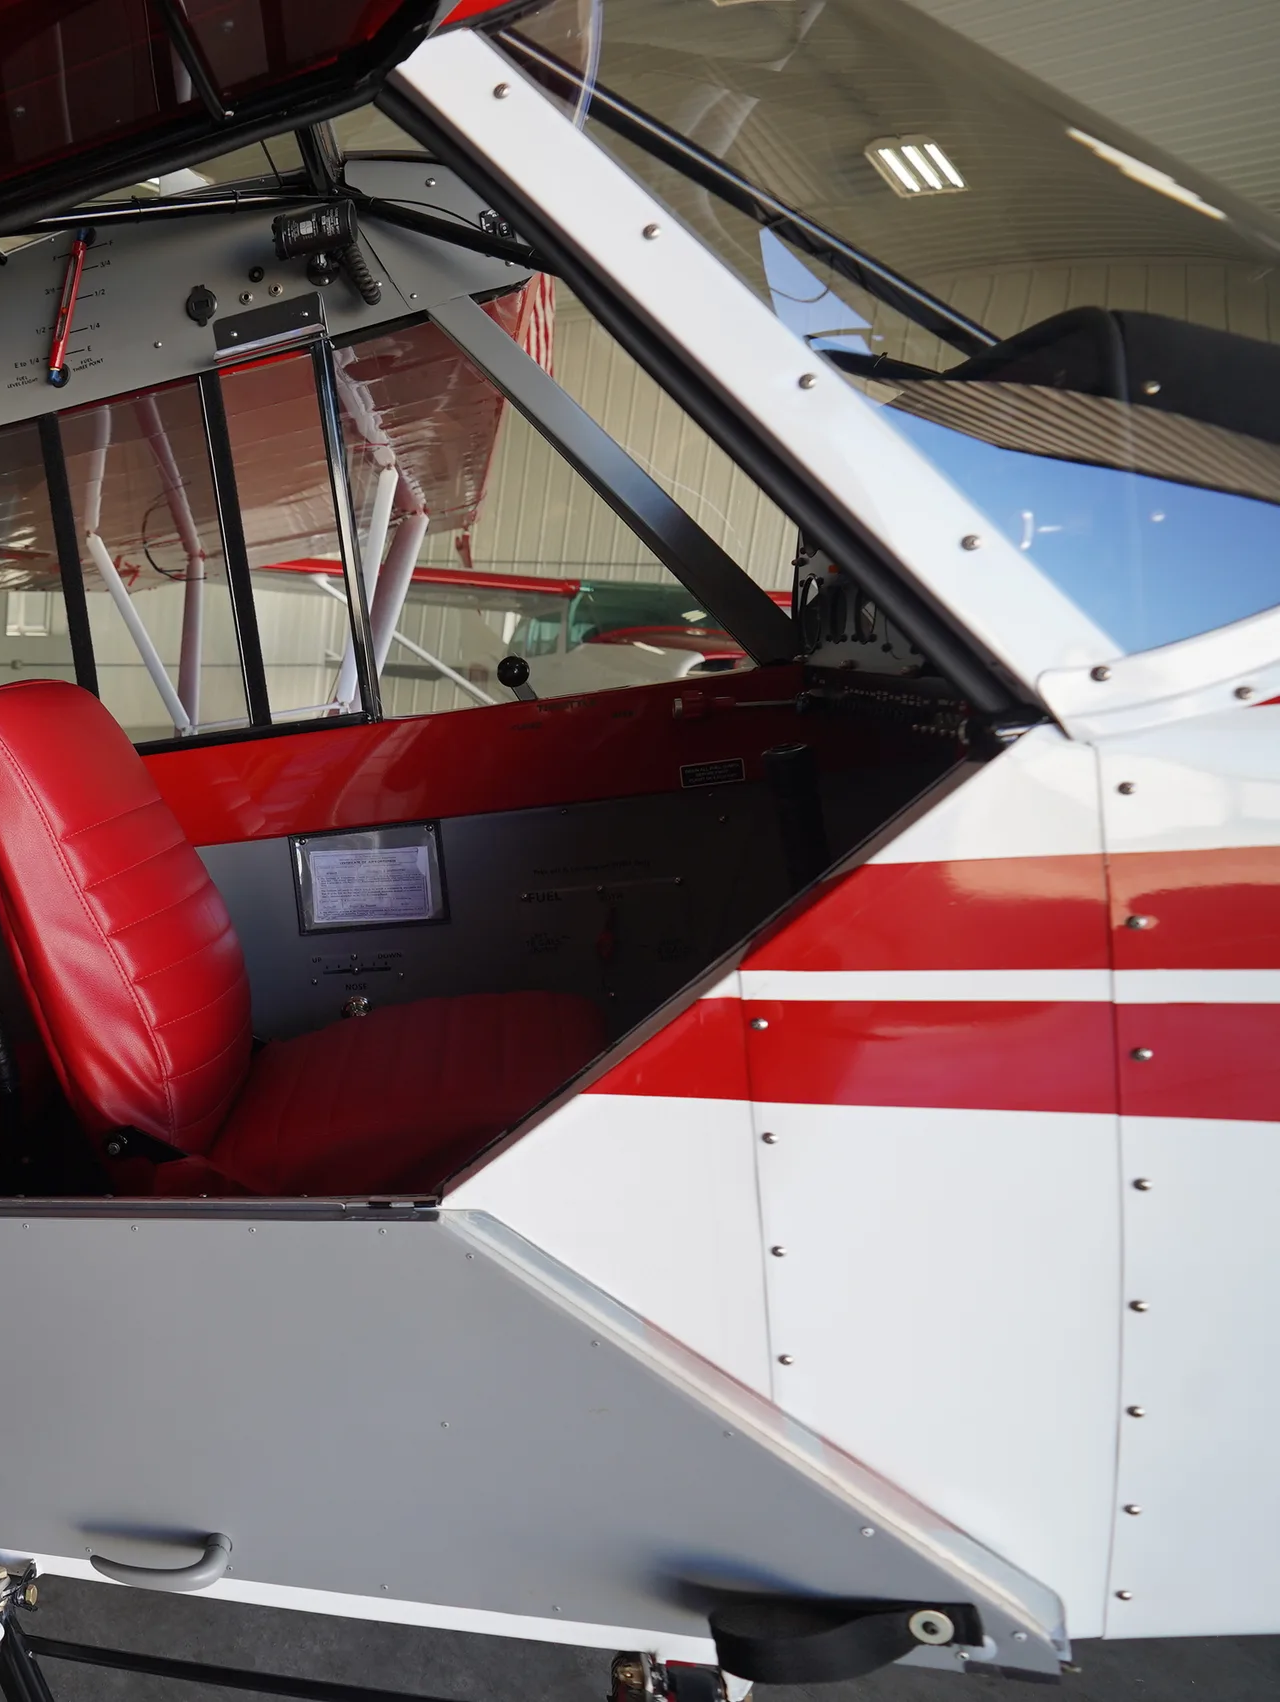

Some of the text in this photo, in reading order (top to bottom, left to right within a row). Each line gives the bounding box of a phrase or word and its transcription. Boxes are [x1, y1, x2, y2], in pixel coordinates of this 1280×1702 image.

[99, 260, 111, 268] 3/4
[35, 326, 46, 334] 1/2
[88, 322, 101, 330] 1/4
[29, 358, 40, 366] 1/4
[527, 891, 563, 903] FUEL
[344, 983, 367, 991] NOSE
